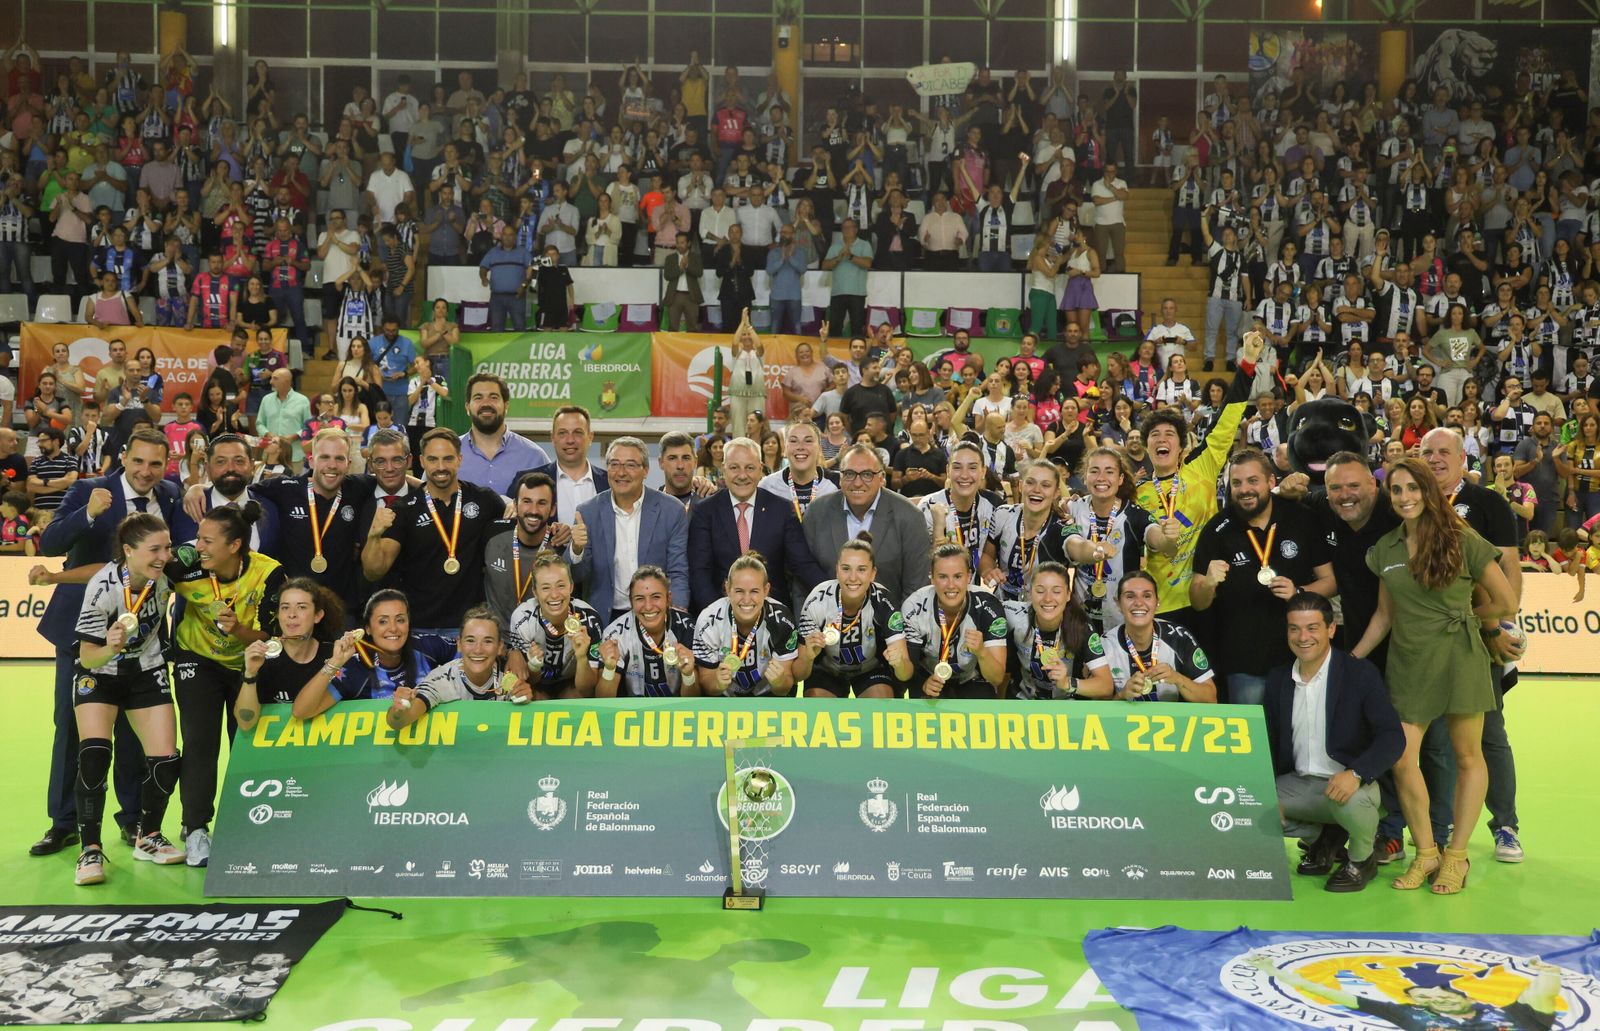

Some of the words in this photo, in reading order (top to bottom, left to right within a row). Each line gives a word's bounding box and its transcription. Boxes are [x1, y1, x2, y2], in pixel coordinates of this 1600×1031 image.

[529, 343, 566, 360] LIGA
[155, 358, 185, 369] STA
[583, 363, 641, 373] IBERDROLA
[476, 362, 572, 380] GUERRERAS
[964, 527, 978, 548] 19
[16, 593, 45, 618] de
[842, 626, 860, 644] 22
[545, 650, 561, 665] 27
[649, 662, 660, 680] 6
[507, 710, 603, 747] LIGA
[613, 711, 863, 748] GUERRERAS
[872, 712, 1110, 751] IBERDROLA
[1125, 715, 1253, 754] 22/23
[587, 790, 609, 799] Real
[916, 792, 938, 801] Real
[586, 800, 640, 810] Federación
[736, 801, 783, 811] BERDROLA
[917, 803, 969, 812] Federación
[373, 811, 470, 826] IBERDROLA
[586, 811, 630, 822] Española
[917, 813, 961, 824] Española
[585, 822, 599, 831] de
[599, 823, 656, 832] Balonmano
[917, 824, 931, 833] de
[931, 824, 987, 833] Balonmano
[1051, 816, 1145, 830] IBERDROLA
[624, 866, 662, 875] helvetia
[780, 863, 822, 876] sacyr
[907, 871, 933, 879] Ceuta
[986, 863, 1028, 880] renfe
[1038, 866, 1069, 877] AVIS
[1160, 869, 1195, 878] aquaservice
[1207, 867, 1236, 880] AON
[1245, 869, 1273, 879] Gerflor
[685, 873, 727, 882] Santander
[821, 966, 1124, 1009] LIGA
